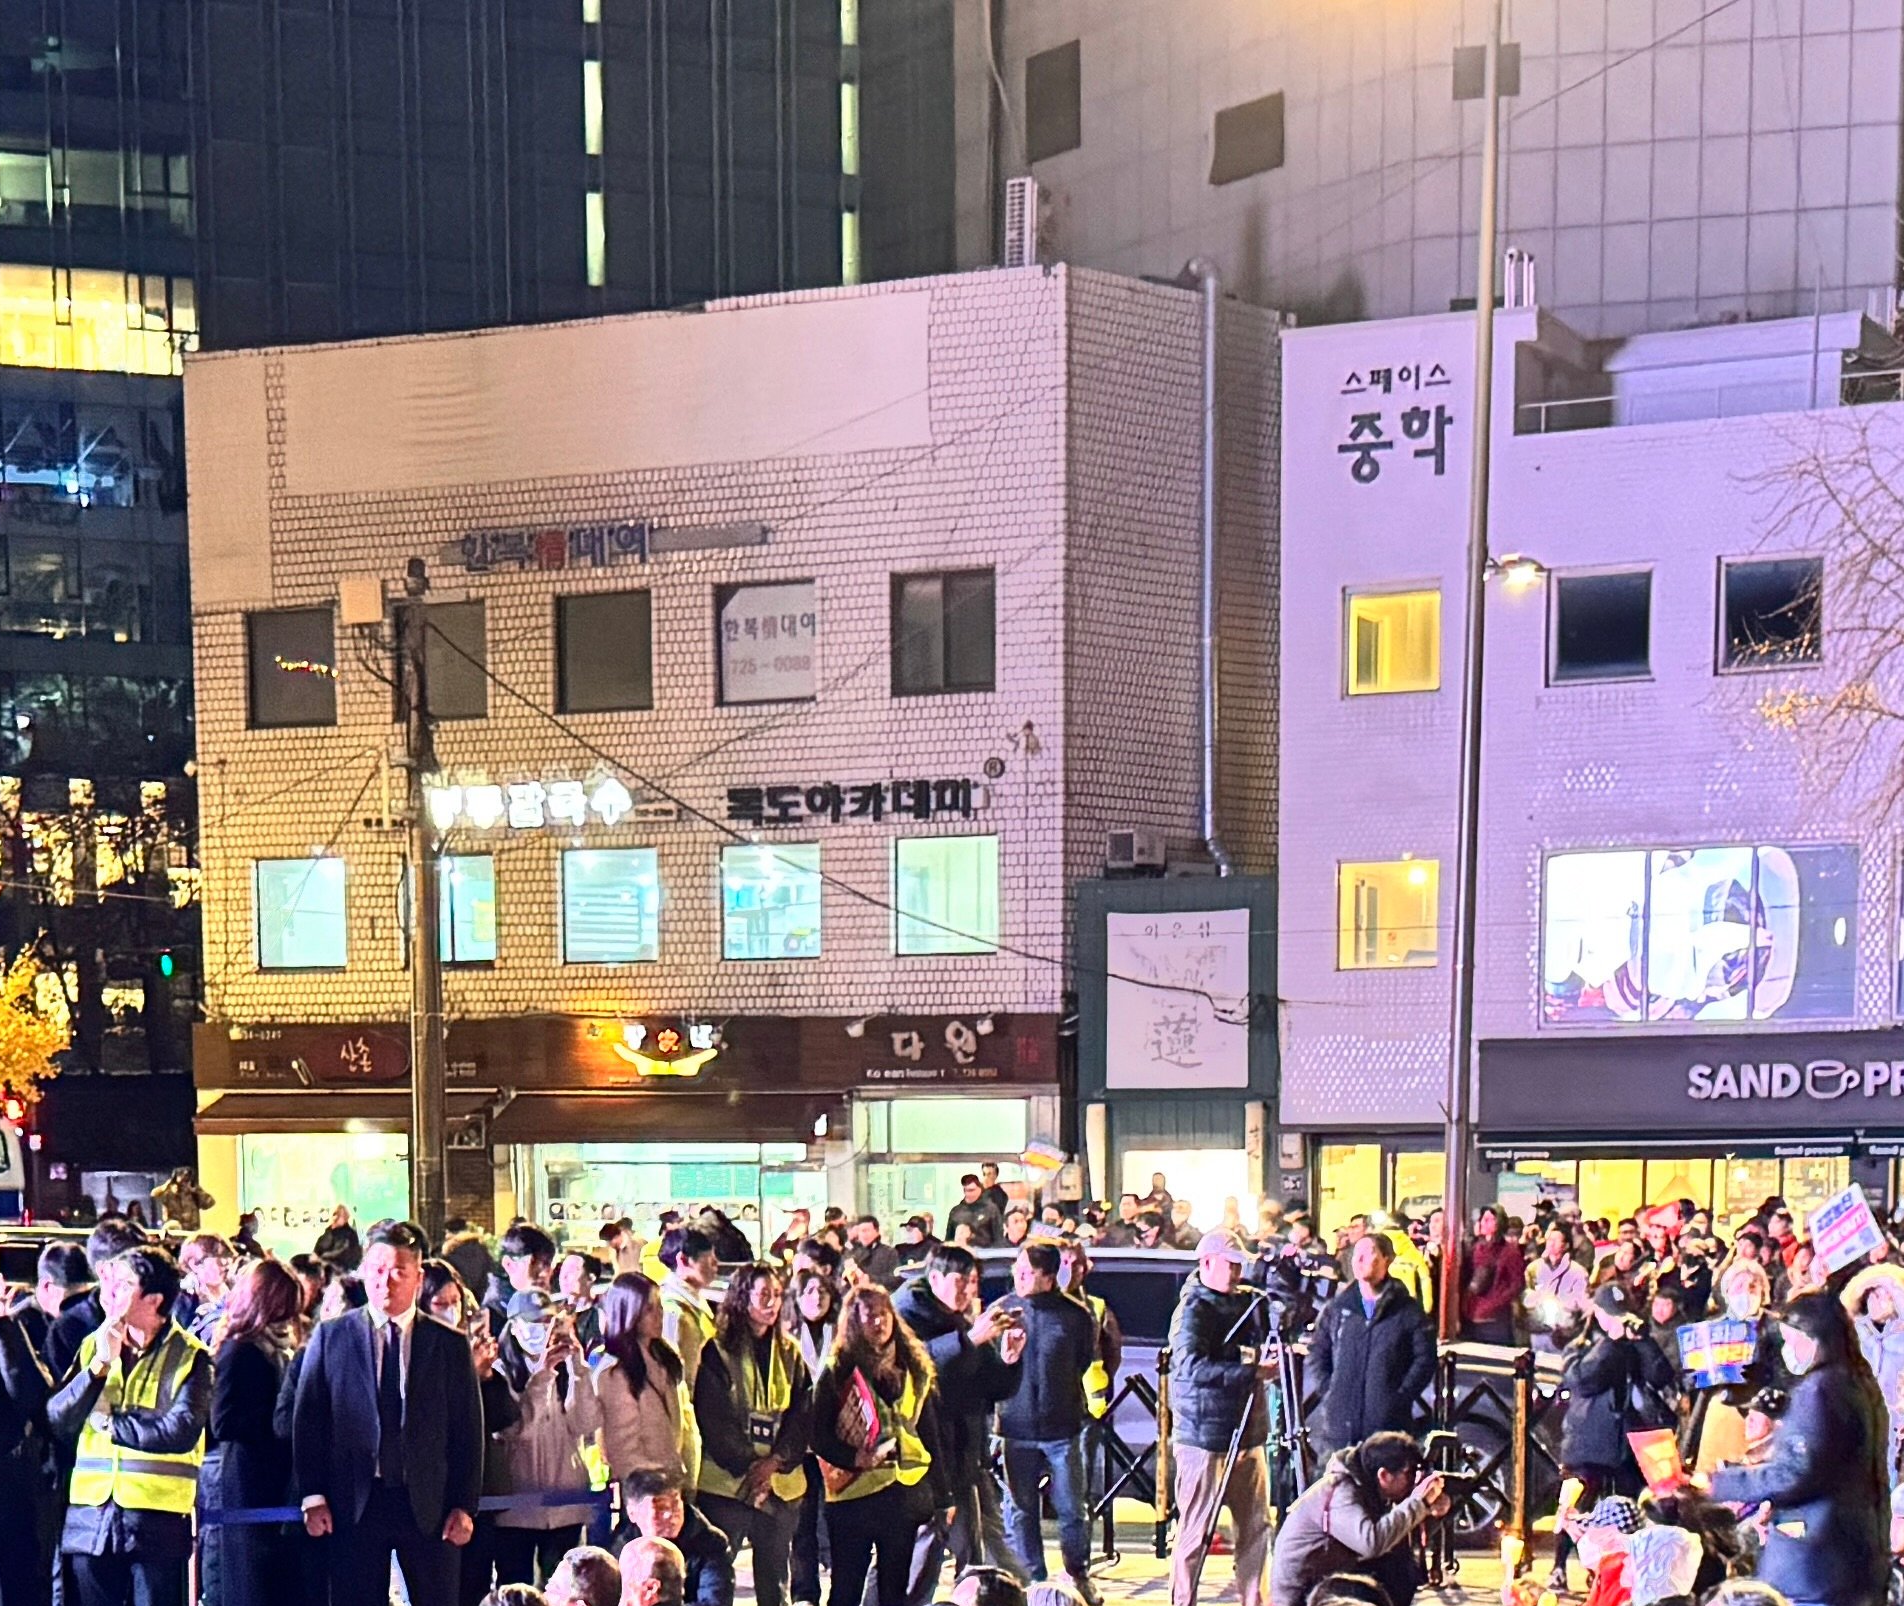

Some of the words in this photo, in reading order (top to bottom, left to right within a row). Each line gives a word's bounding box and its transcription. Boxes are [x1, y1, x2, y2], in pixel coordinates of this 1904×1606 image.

[1341, 364, 1452, 394] 스페이스
[1337, 404, 1454, 484] 중학
[1687, 1062, 1801, 1099] SAND
